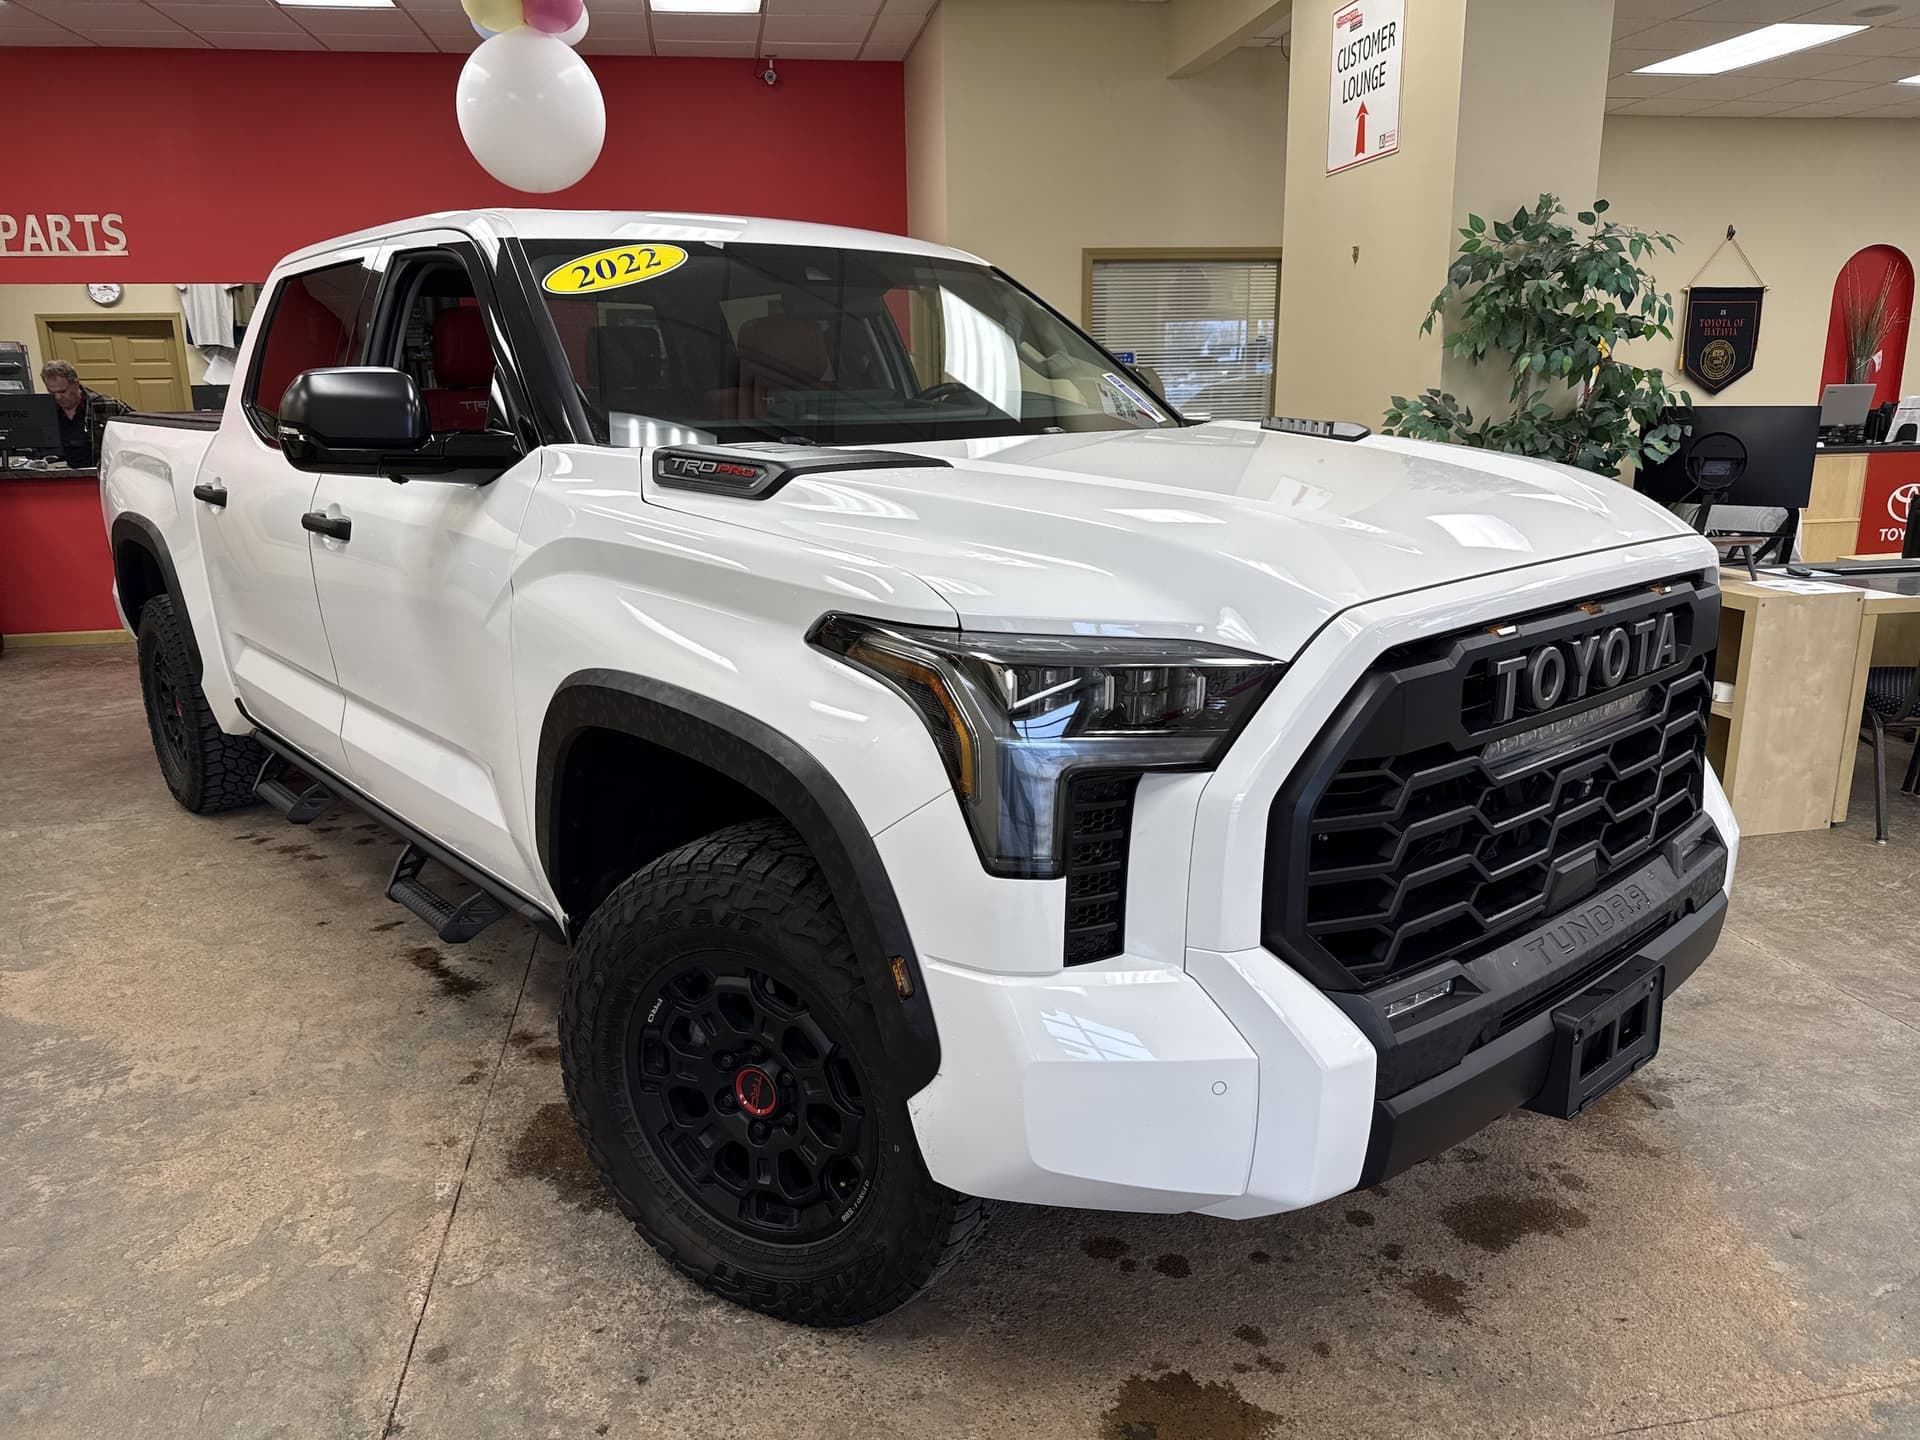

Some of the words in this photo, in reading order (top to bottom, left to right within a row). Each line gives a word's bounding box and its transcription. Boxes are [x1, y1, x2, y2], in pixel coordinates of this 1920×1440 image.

[1337, 21, 1396, 74] CUSTOMER
[1342, 60, 1387, 104] LOUNGE
[0, 213, 128, 255] PARTS
[571, 248, 662, 288] 2022
[1699, 318, 1731, 328] TOYOTA
[1733, 318, 1745, 328] OF
[1704, 327, 1737, 337] BATAVIA
[459, 400, 487, 413] TR
[672, 457, 717, 475] TRD
[716, 463, 757, 478] PRO
[1879, 528, 1906, 542] TOY
[1496, 612, 1677, 721] TOYOTA
[1523, 884, 1651, 965] TUNDRA
